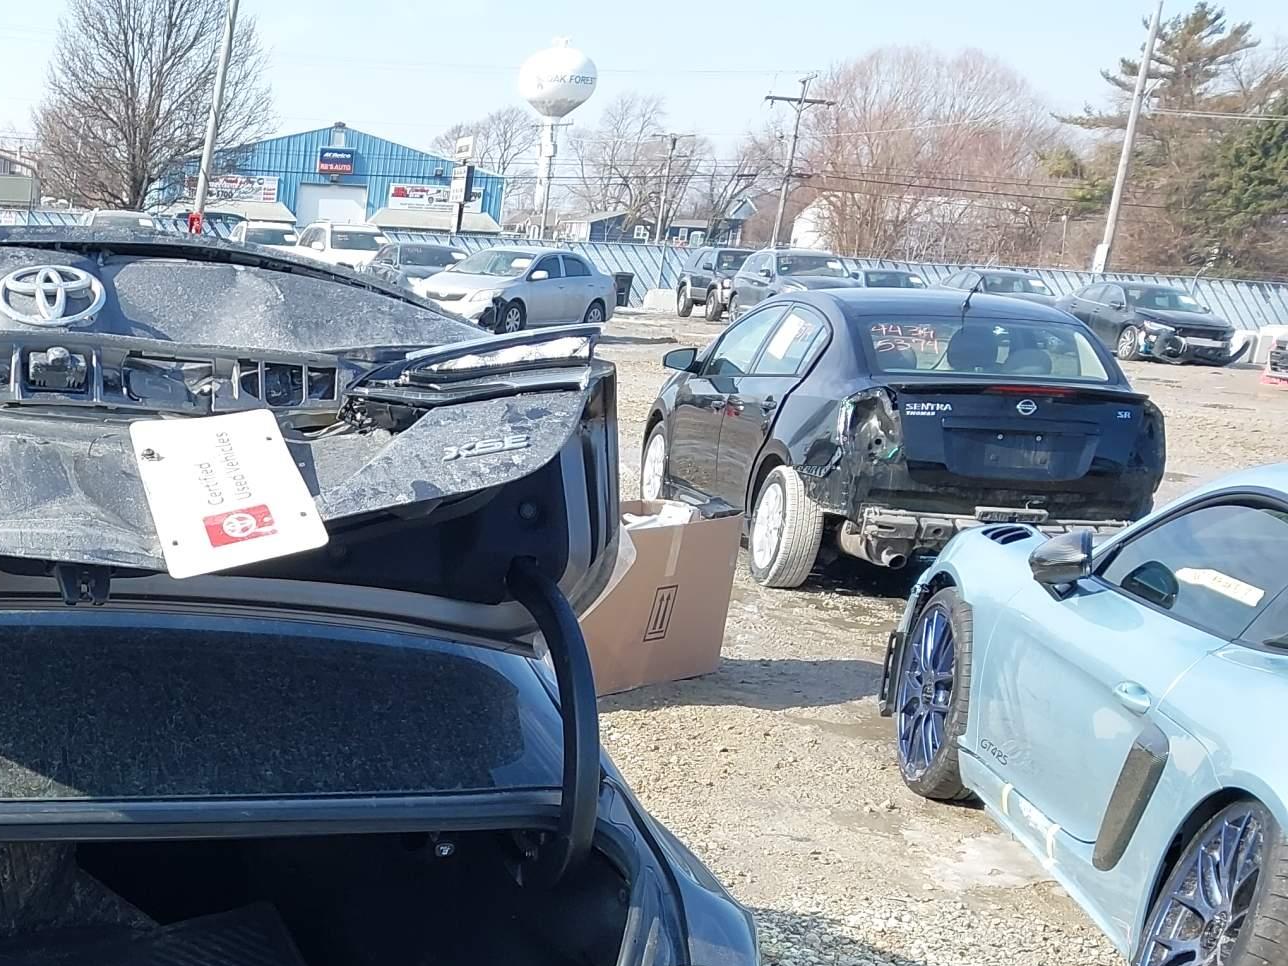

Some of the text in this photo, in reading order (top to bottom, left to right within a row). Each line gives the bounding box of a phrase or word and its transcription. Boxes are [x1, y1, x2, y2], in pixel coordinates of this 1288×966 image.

[905, 402, 952, 411] SENTRA
[1117, 410, 1131, 419] SR
[441, 434, 531, 463] XSE
[215, 431, 252, 500] Used Vehicles
[194, 461, 224, 506] Certified
[980, 738, 1009, 766] GT4RS
